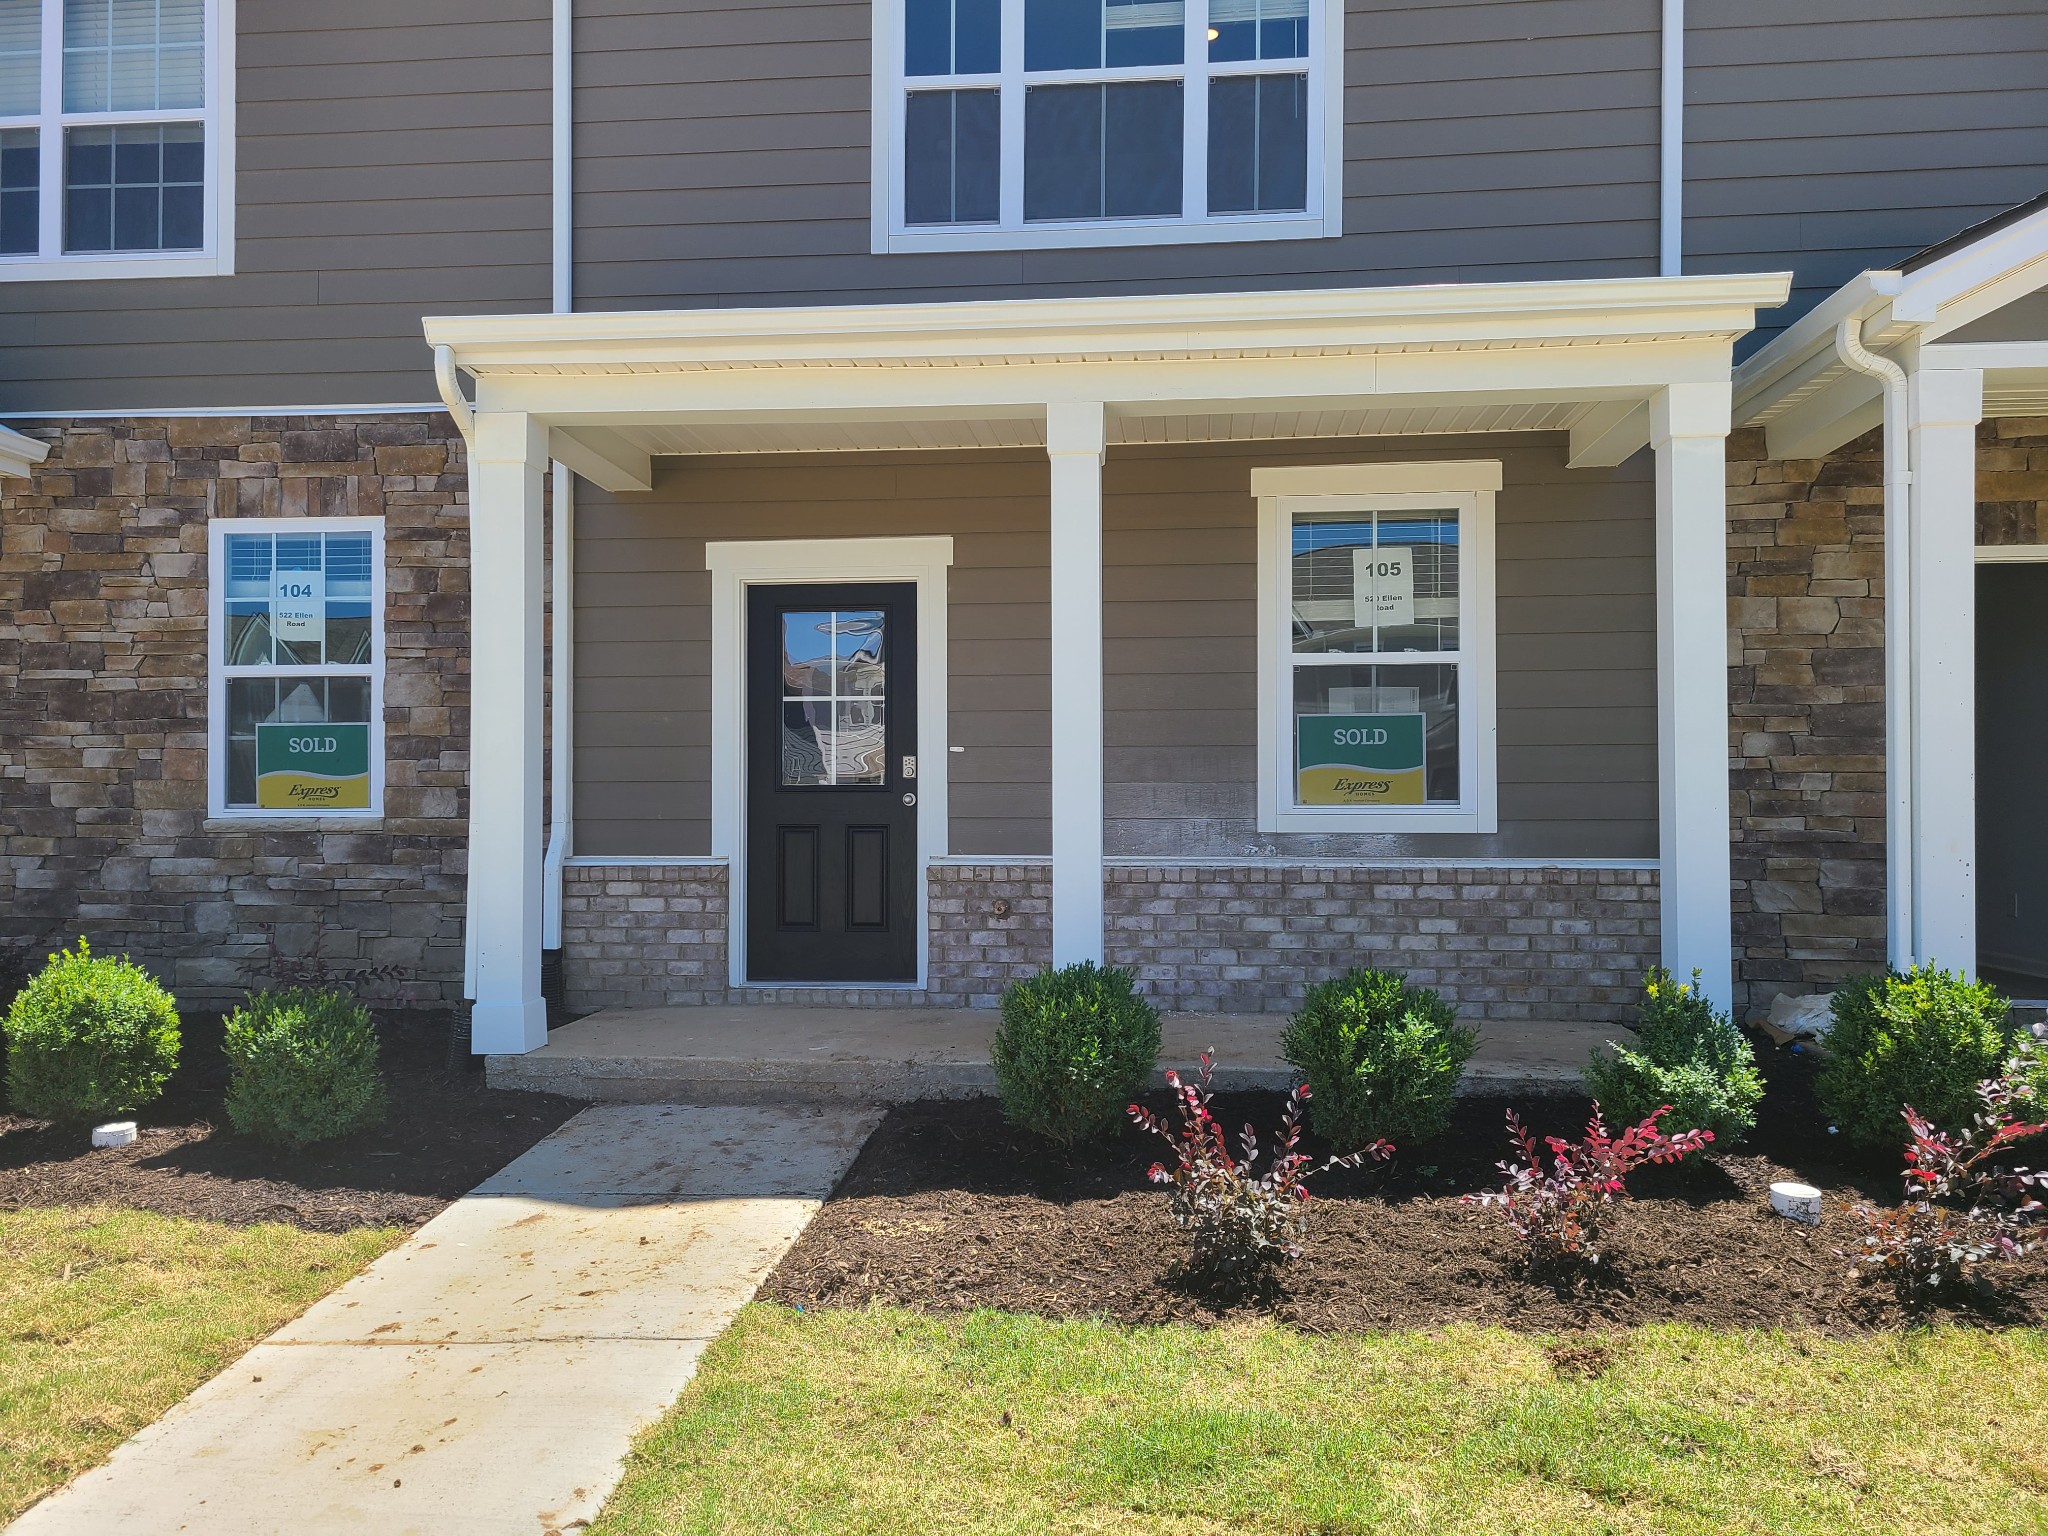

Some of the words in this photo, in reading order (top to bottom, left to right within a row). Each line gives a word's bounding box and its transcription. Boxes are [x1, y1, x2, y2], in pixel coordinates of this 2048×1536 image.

[1365, 561, 1402, 578] 105
[279, 584, 312, 598] 104
[1382, 594, 1403, 602] Ellen
[288, 737, 337, 753] SOLD
[1333, 728, 1388, 746] SOLD
[288, 784, 340, 801] Express
[1332, 778, 1392, 797] Express
